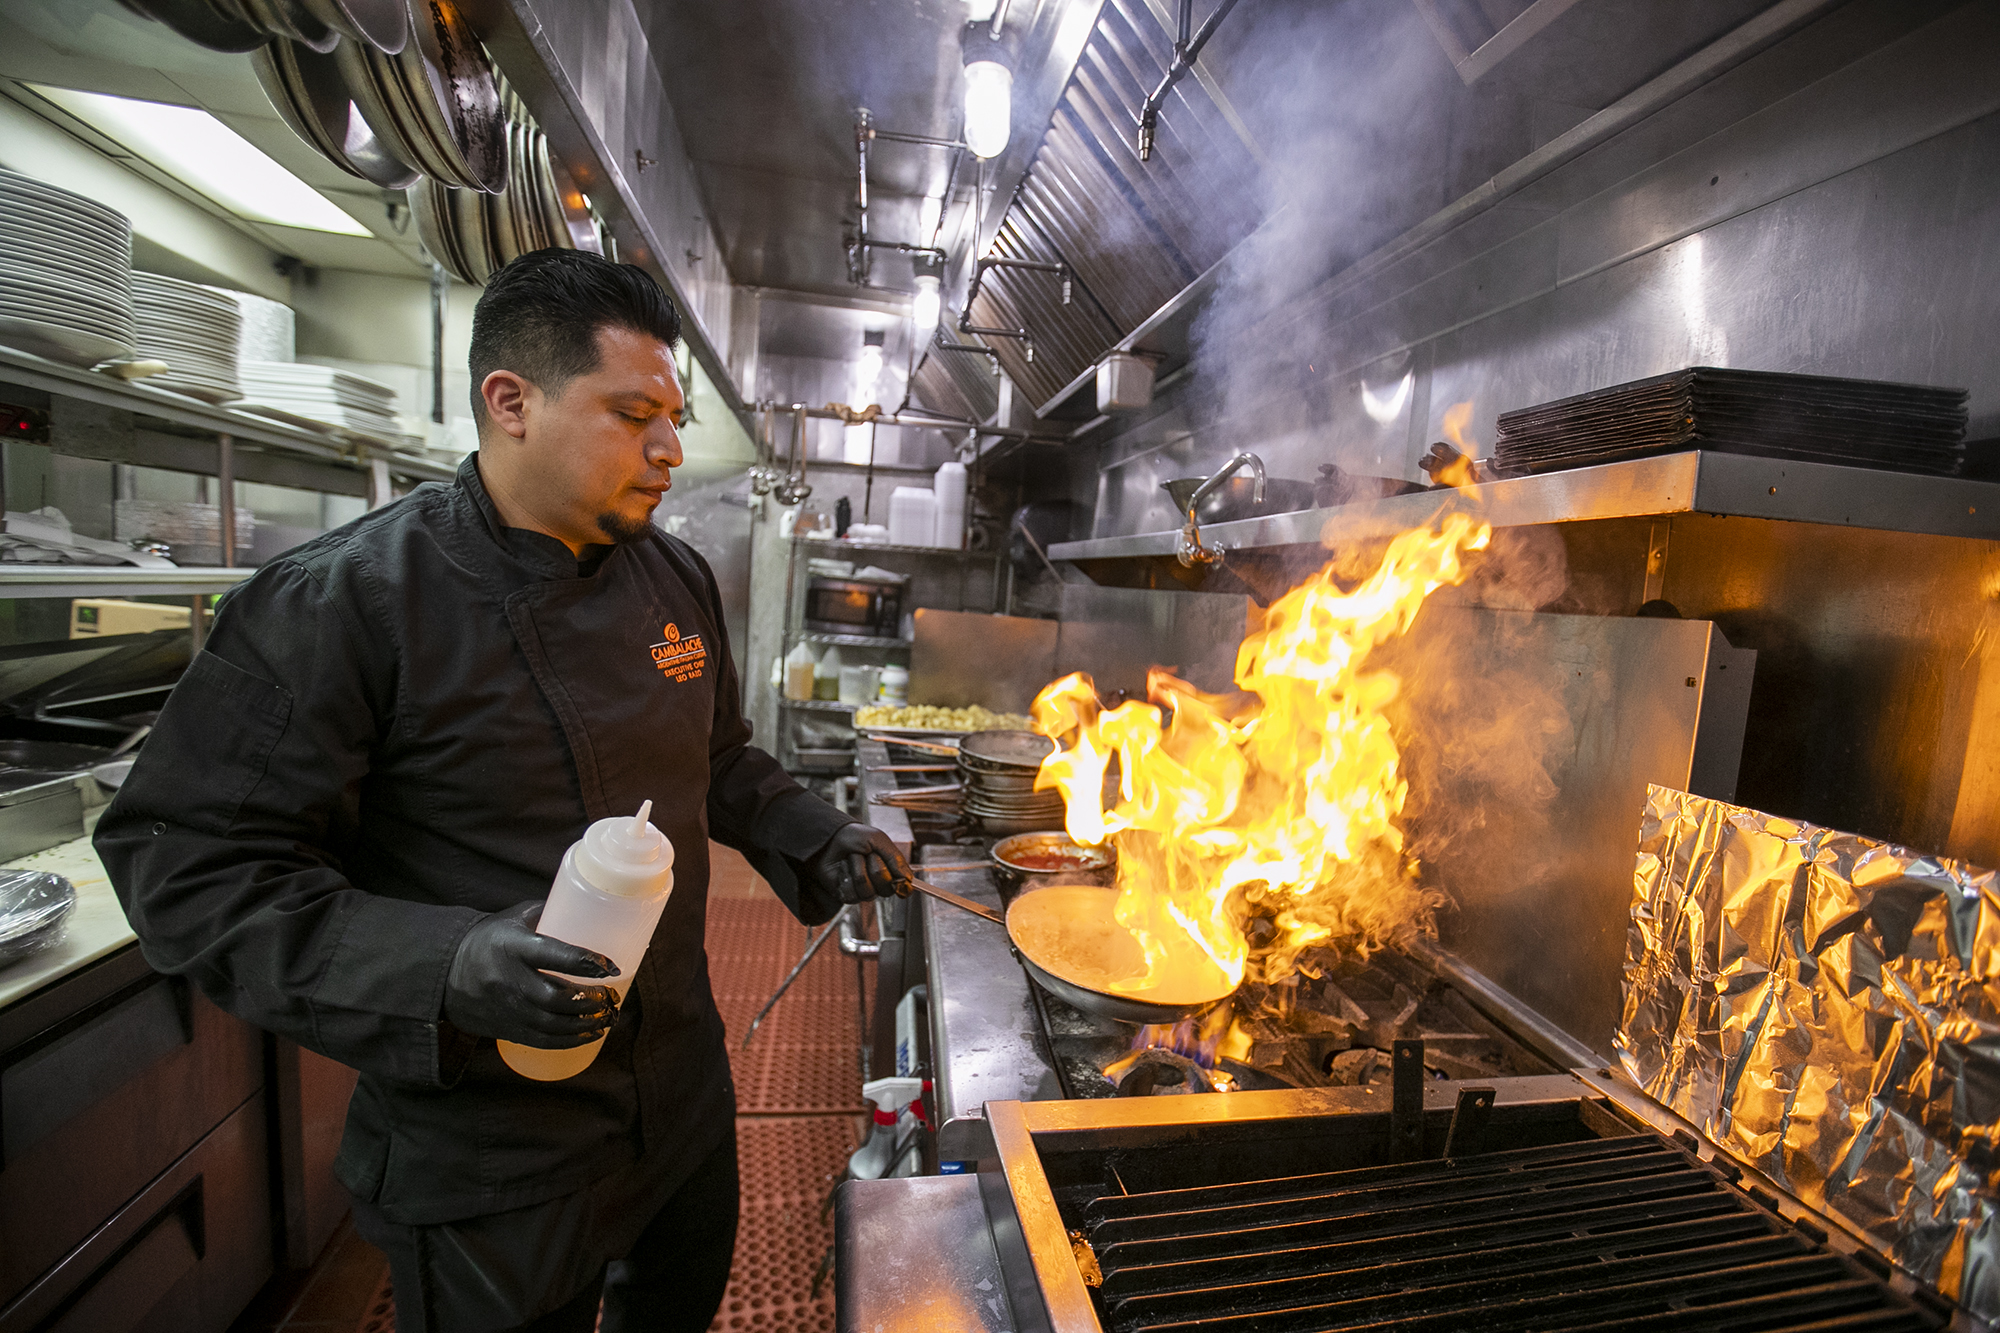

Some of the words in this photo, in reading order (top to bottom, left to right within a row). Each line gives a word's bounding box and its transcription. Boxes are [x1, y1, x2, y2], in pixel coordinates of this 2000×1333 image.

[651, 637, 704, 661] CAMBALACHE
[664, 663, 694, 678] EXECUTIVE
[675, 673, 688, 683] LEO
